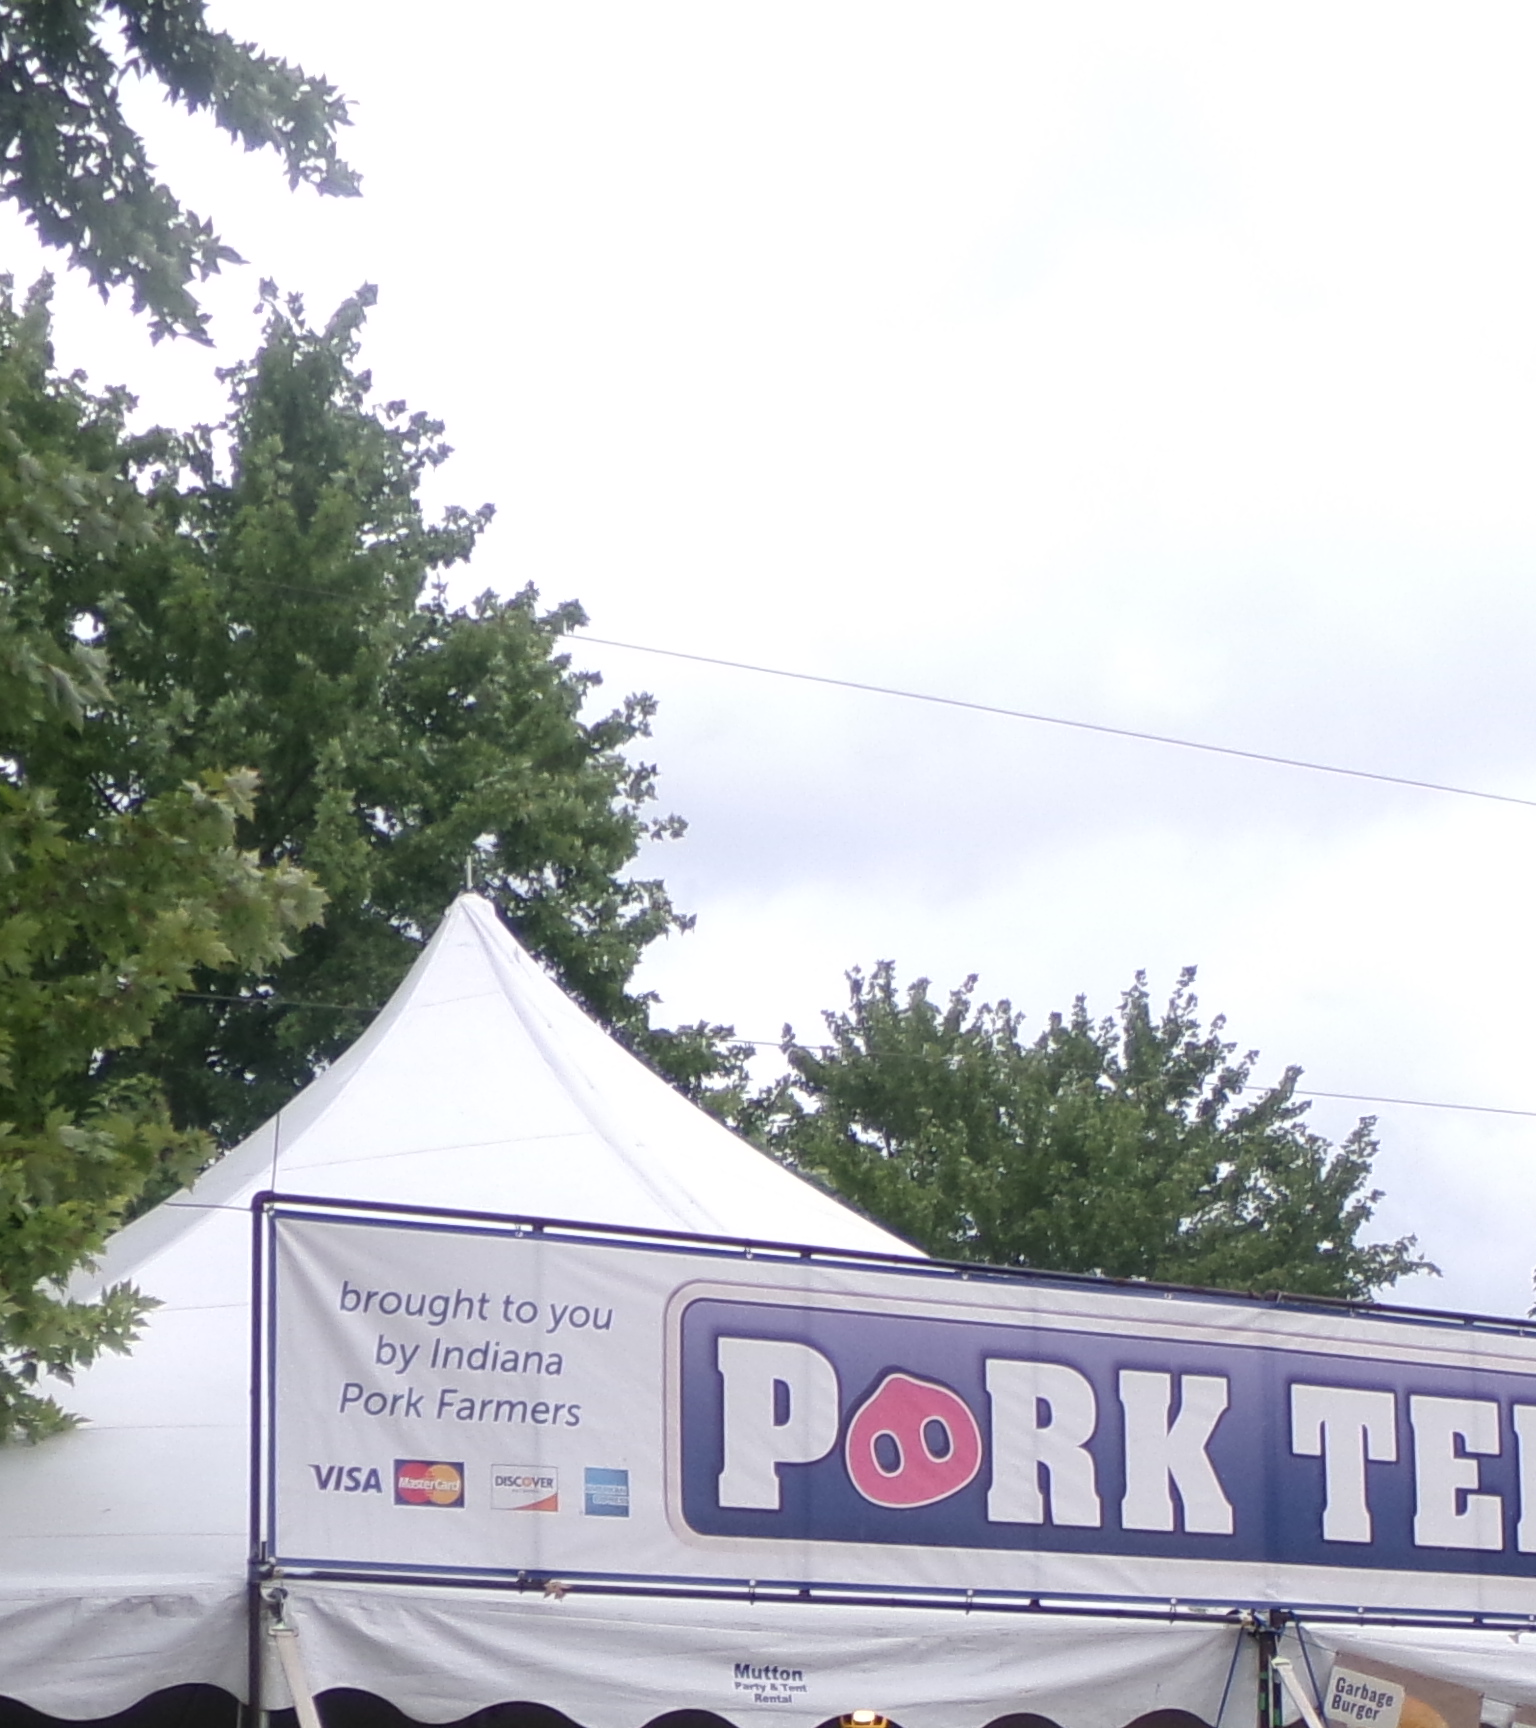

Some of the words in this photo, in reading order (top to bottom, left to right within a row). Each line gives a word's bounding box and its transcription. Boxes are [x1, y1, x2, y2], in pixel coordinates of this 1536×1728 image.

[339, 1280, 490, 1327] brought
[502, 1294, 538, 1324] to
[545, 1303, 613, 1334] you
[375, 1334, 420, 1375] by
[430, 1337, 564, 1376] Indiana
[339, 1382, 425, 1418] Pork
[436, 1388, 582, 1427] Farmers
[308, 1464, 383, 1494] VISA
[398, 1475, 460, 1492] MasterCard
[494, 1475, 553, 1490] DISCOVER
[734, 1663, 803, 1682] Mutton
[734, 1681, 767, 1693] Party
[770, 1683, 779, 1692] &
[780, 1683, 808, 1693] Tent
[754, 1693, 793, 1704] Rental
[1335, 1676, 1394, 1708] Garbage
[1331, 1693, 1381, 1721] Burger
